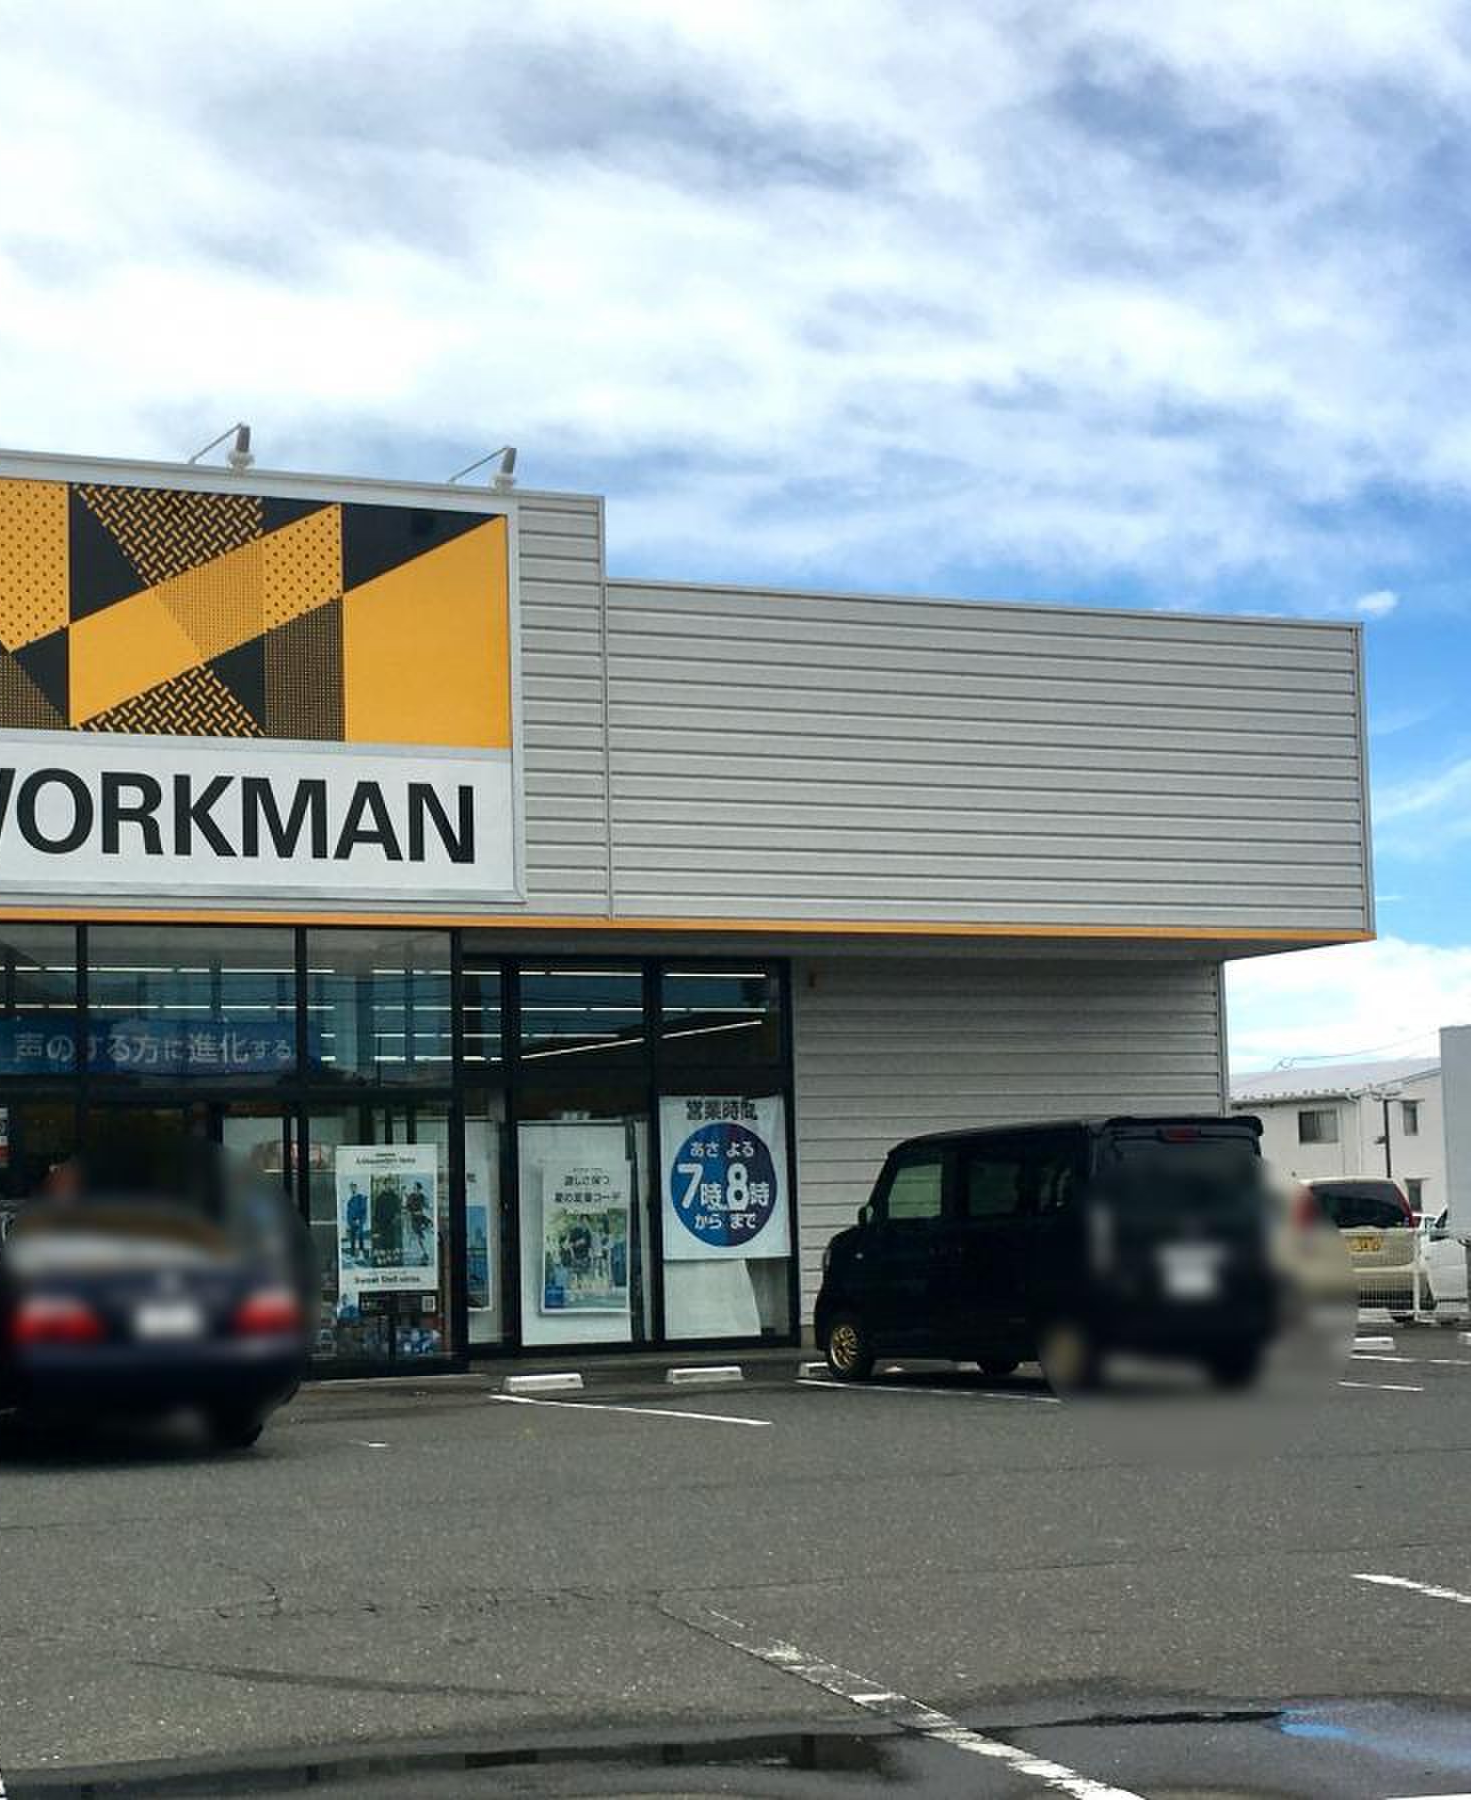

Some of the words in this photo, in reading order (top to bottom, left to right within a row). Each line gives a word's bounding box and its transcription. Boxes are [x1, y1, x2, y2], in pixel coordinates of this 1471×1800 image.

[686, 1099, 758, 1120] 営業時間
[689, 1141, 720, 1158] あさ
[726, 1141, 754, 1158] よる
[694, 1213, 723, 1230] から
[730, 1213, 757, 1230] まで
